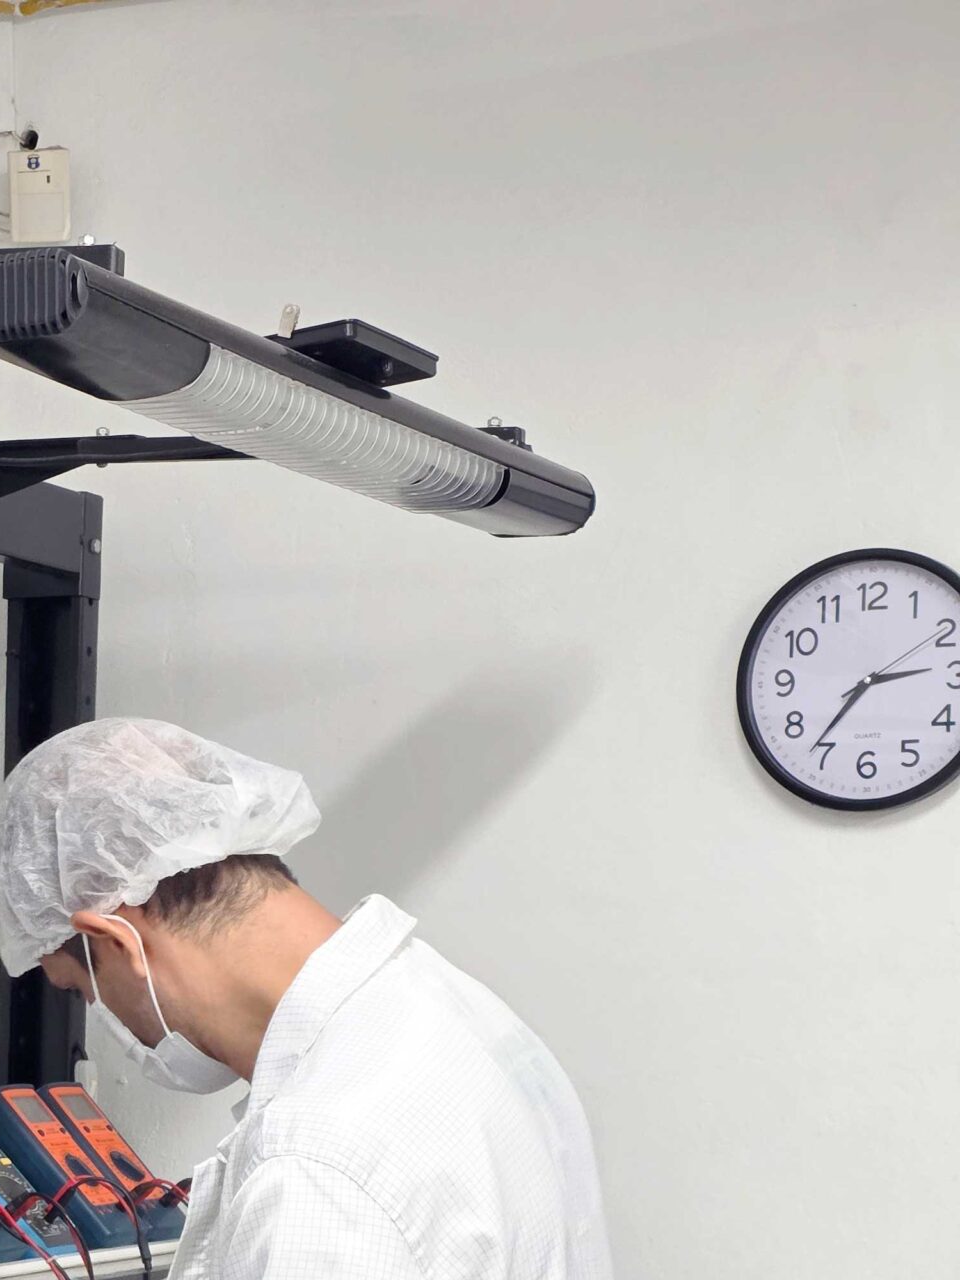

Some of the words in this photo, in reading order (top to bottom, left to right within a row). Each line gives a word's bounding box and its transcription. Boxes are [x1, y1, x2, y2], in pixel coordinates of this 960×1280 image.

[817, 595, 841, 624] 11
[857, 581, 888, 611] 12
[908, 591, 918, 619] 1
[784, 627, 818, 658] 10
[935, 618, 956, 647] 2
[775, 669, 795, 697] 9
[945, 660, 960, 690] 3
[785, 710, 804, 739] 8
[931, 704, 955, 732] 4
[854, 732, 882, 740] QUARTZ
[816, 742, 836, 770] 7
[856, 751, 877, 779] 6
[900, 739, 920, 767] 5
